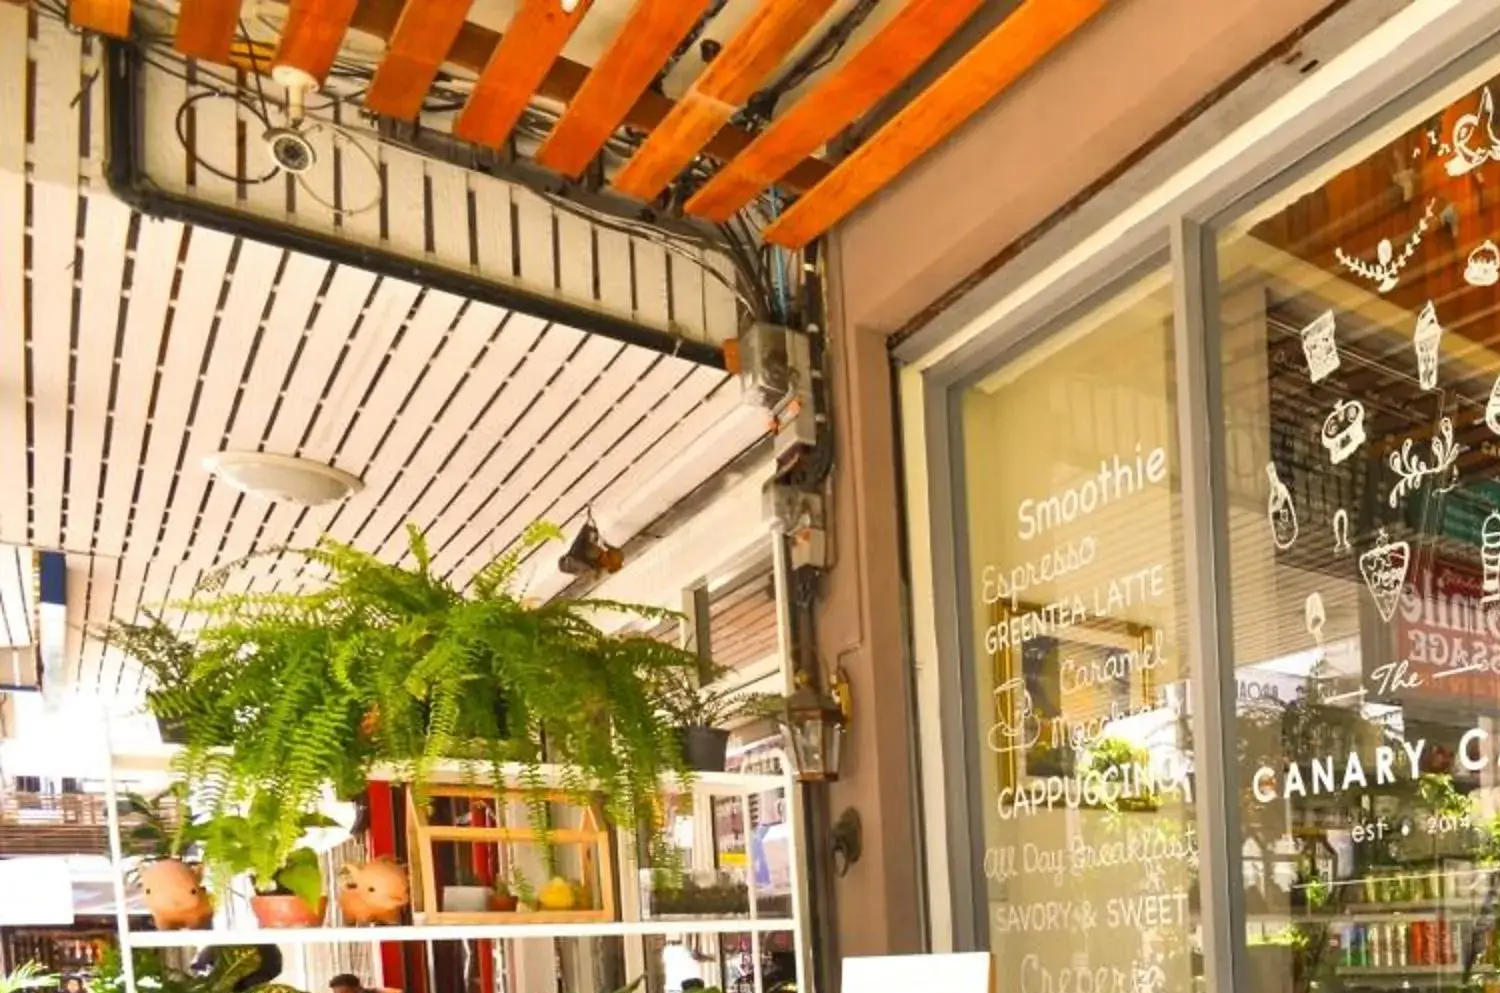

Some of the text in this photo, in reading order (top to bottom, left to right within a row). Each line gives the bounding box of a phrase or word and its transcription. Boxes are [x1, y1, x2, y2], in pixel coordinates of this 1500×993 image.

[1018, 443, 1167, 540] Smoothie
[982, 535, 1097, 611] Espresso
[1094, 564, 1165, 617] LATTE
[1060, 629, 1168, 694] Caramel
[1371, 661, 1425, 699] The
[997, 754, 1180, 820] CAPPUCCINO
[1252, 739, 1427, 803] CANARY
[1023, 842, 1065, 888] Day
[995, 890, 1189, 932] SAVORY & SWEET
